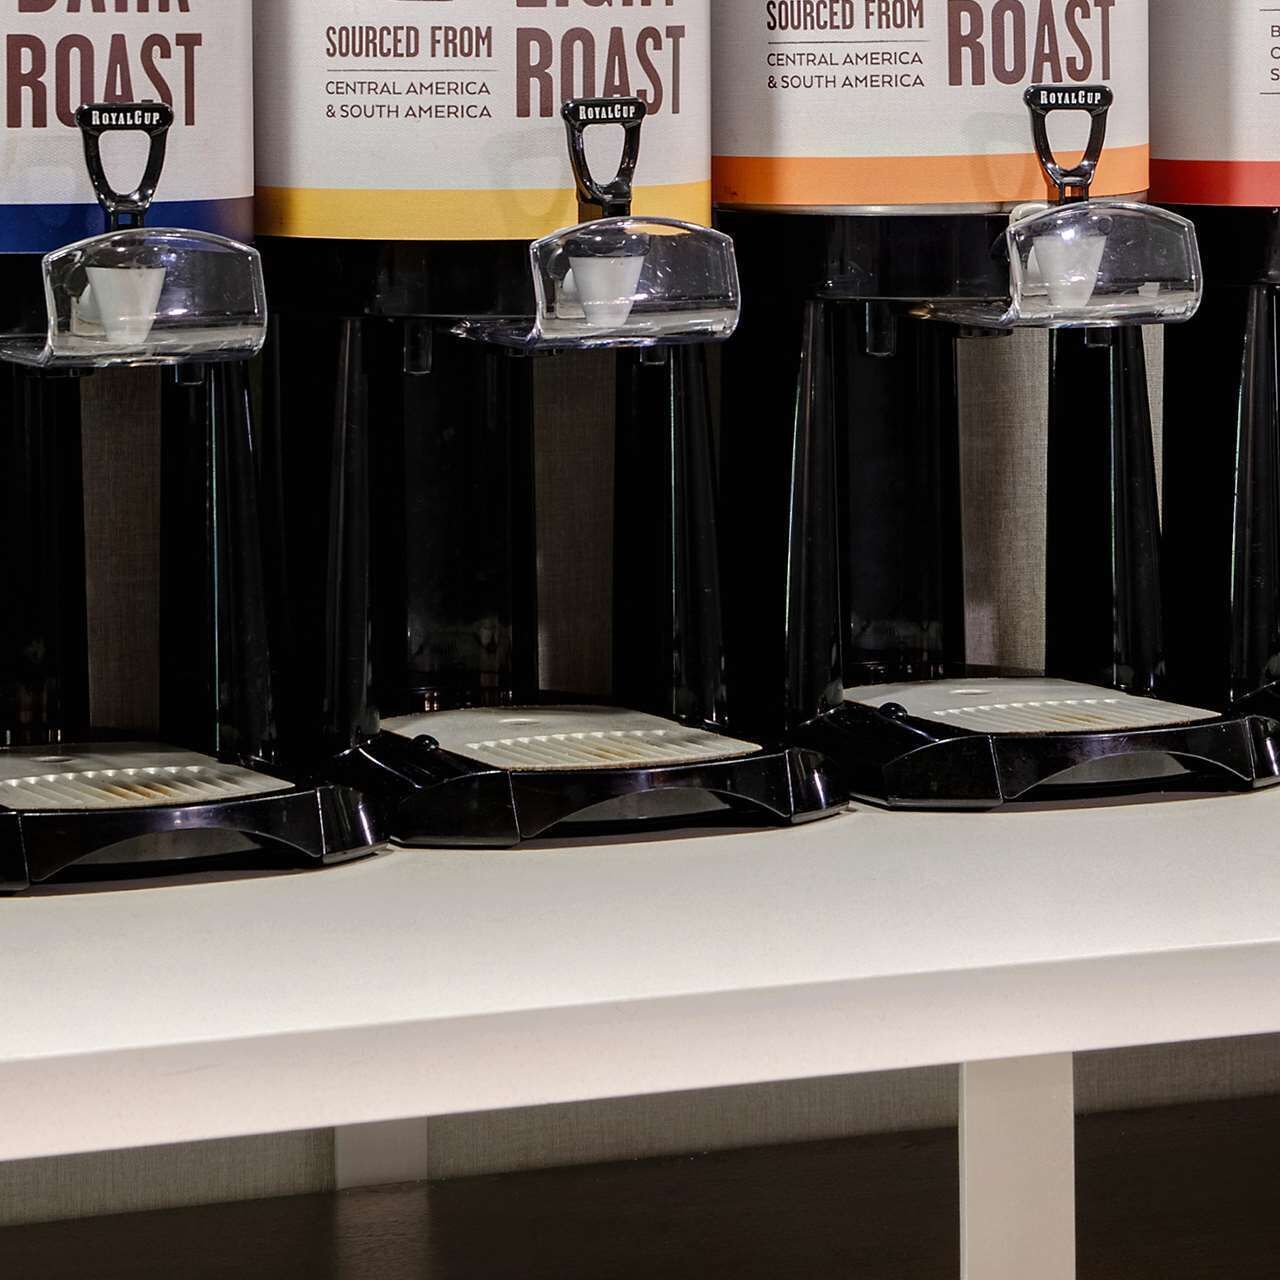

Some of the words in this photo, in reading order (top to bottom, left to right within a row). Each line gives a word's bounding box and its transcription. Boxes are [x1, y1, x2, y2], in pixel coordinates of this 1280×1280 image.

[767, 0, 854, 31] SOURCED
[326, 26, 419, 57] SOURCED
[431, 26, 492, 57] FROM
[767, 53, 842, 67] CENTRAL
[843, 52, 923, 65] AMERICA
[6, 33, 203, 128] ROAST
[516, 25, 685, 118] ROAST
[768, 75, 777, 88] &
[780, 75, 836, 89] SOUTH
[842, 74, 924, 88] AMERICA
[326, 81, 401, 95] CENTRAL
[406, 82, 490, 95] AMERICA
[326, 104, 335, 118] &
[340, 105, 398, 118] SOUTH
[405, 105, 491, 118] AMERICA
